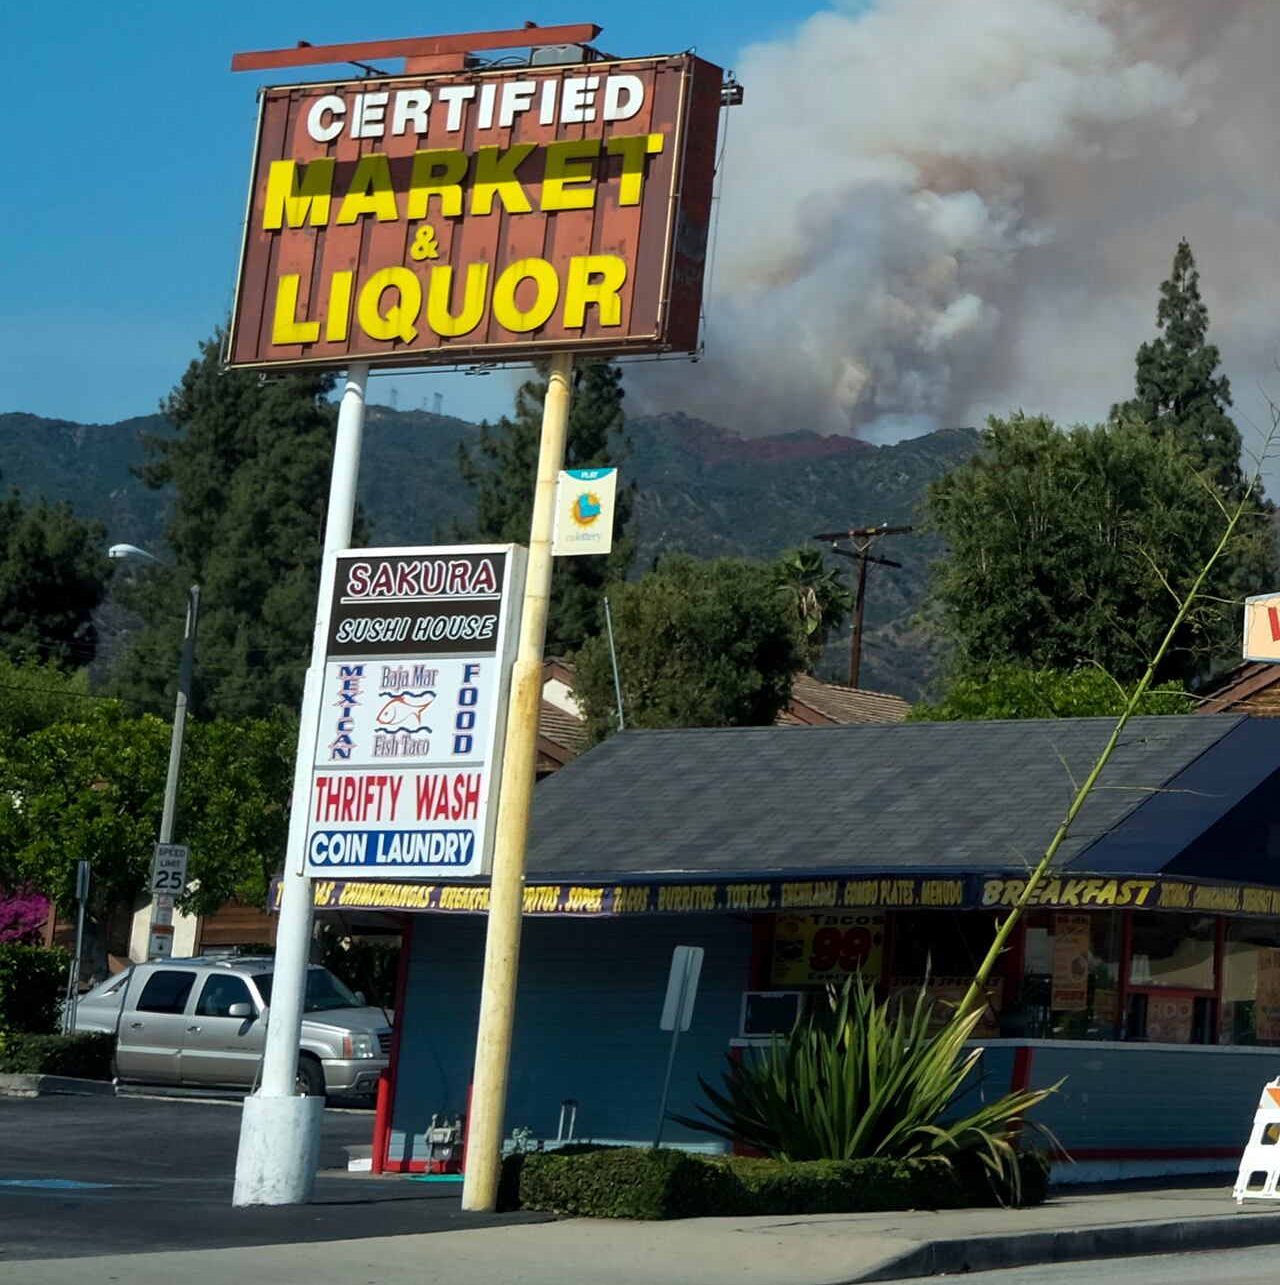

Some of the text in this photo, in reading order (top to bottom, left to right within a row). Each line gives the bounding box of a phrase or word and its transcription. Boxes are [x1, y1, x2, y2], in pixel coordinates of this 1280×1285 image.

[307, 74, 644, 142] CERTIFIED
[262, 133, 664, 230] MARKET
[410, 224, 439, 261] &
[271, 254, 628, 345] LIQUOR
[347, 559, 497, 597] SAKURA
[336, 614, 497, 643] SUSHI HOUSE
[381, 666, 439, 691] Baja Mar
[328, 664, 367, 761] MEXICAN
[453, 664, 481, 755] FOOD
[373, 734, 430, 757] Fish Taco
[315, 773, 482, 822] THRIFTY WASH
[159, 847, 186, 857] SPEED
[310, 832, 473, 864] COIN LAUNDRY
[160, 859, 181, 868] LIMIT
[155, 870, 182, 889] 25
[981, 880, 1156, 906] BREAKFAST
[439, 886, 491, 911] BREAKFA
[658, 885, 718, 912] BURRITOS
[938, 977, 1001, 987] SPECLS
